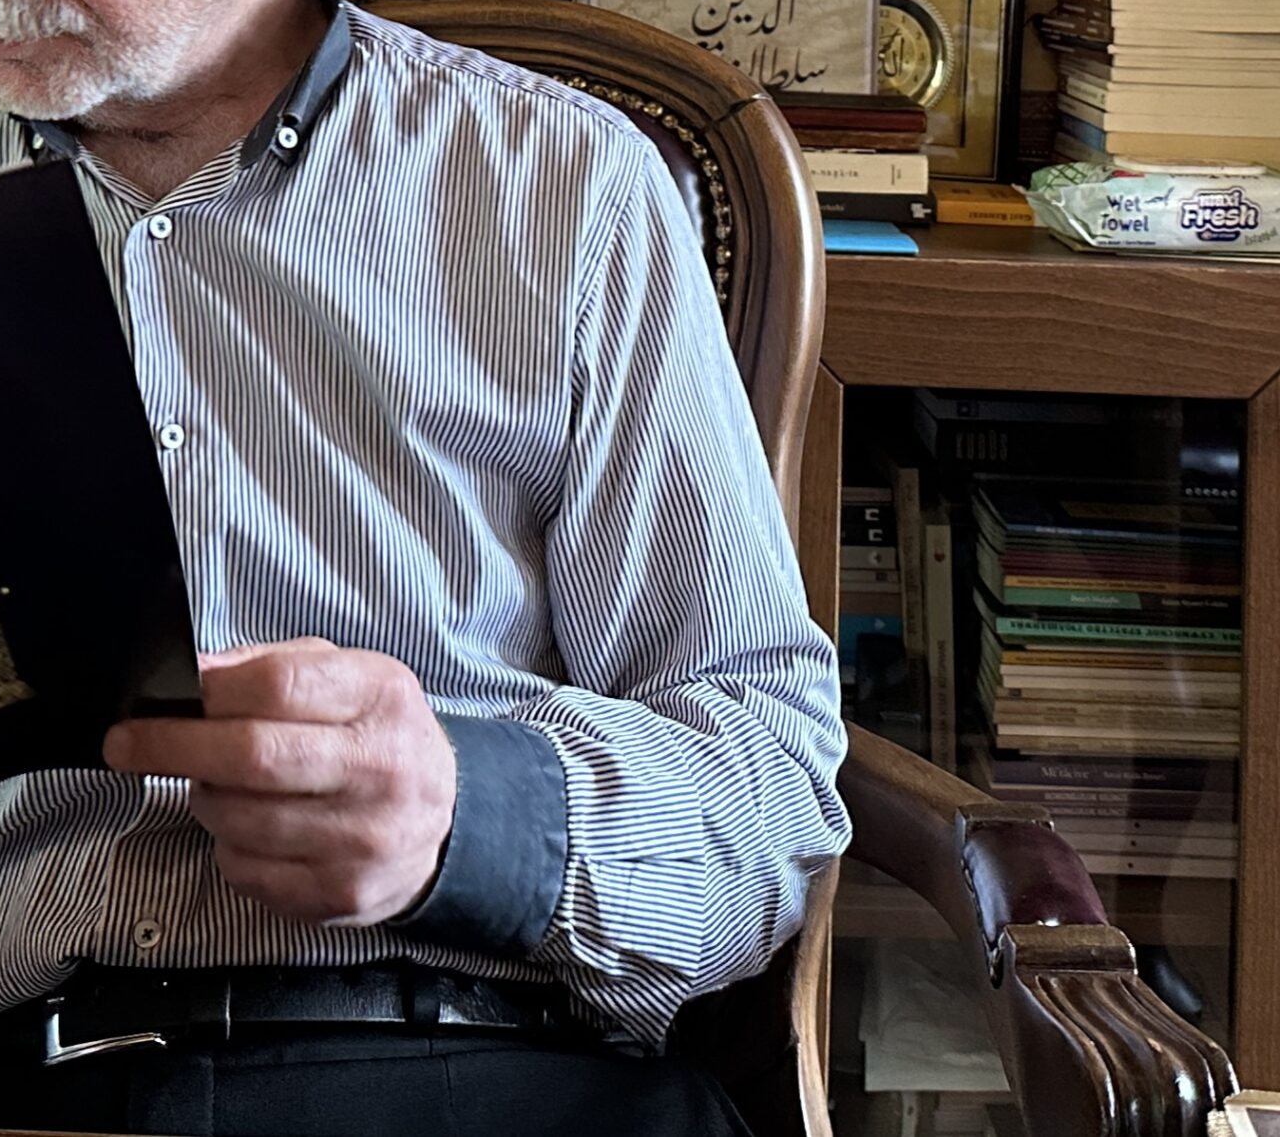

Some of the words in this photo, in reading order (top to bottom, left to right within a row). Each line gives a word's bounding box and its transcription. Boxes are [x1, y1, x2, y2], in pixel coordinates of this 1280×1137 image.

[1107, 195, 1142, 212] Wet
[1100, 213, 1150, 233] Towel
[1182, 203, 1258, 229] Fresh
